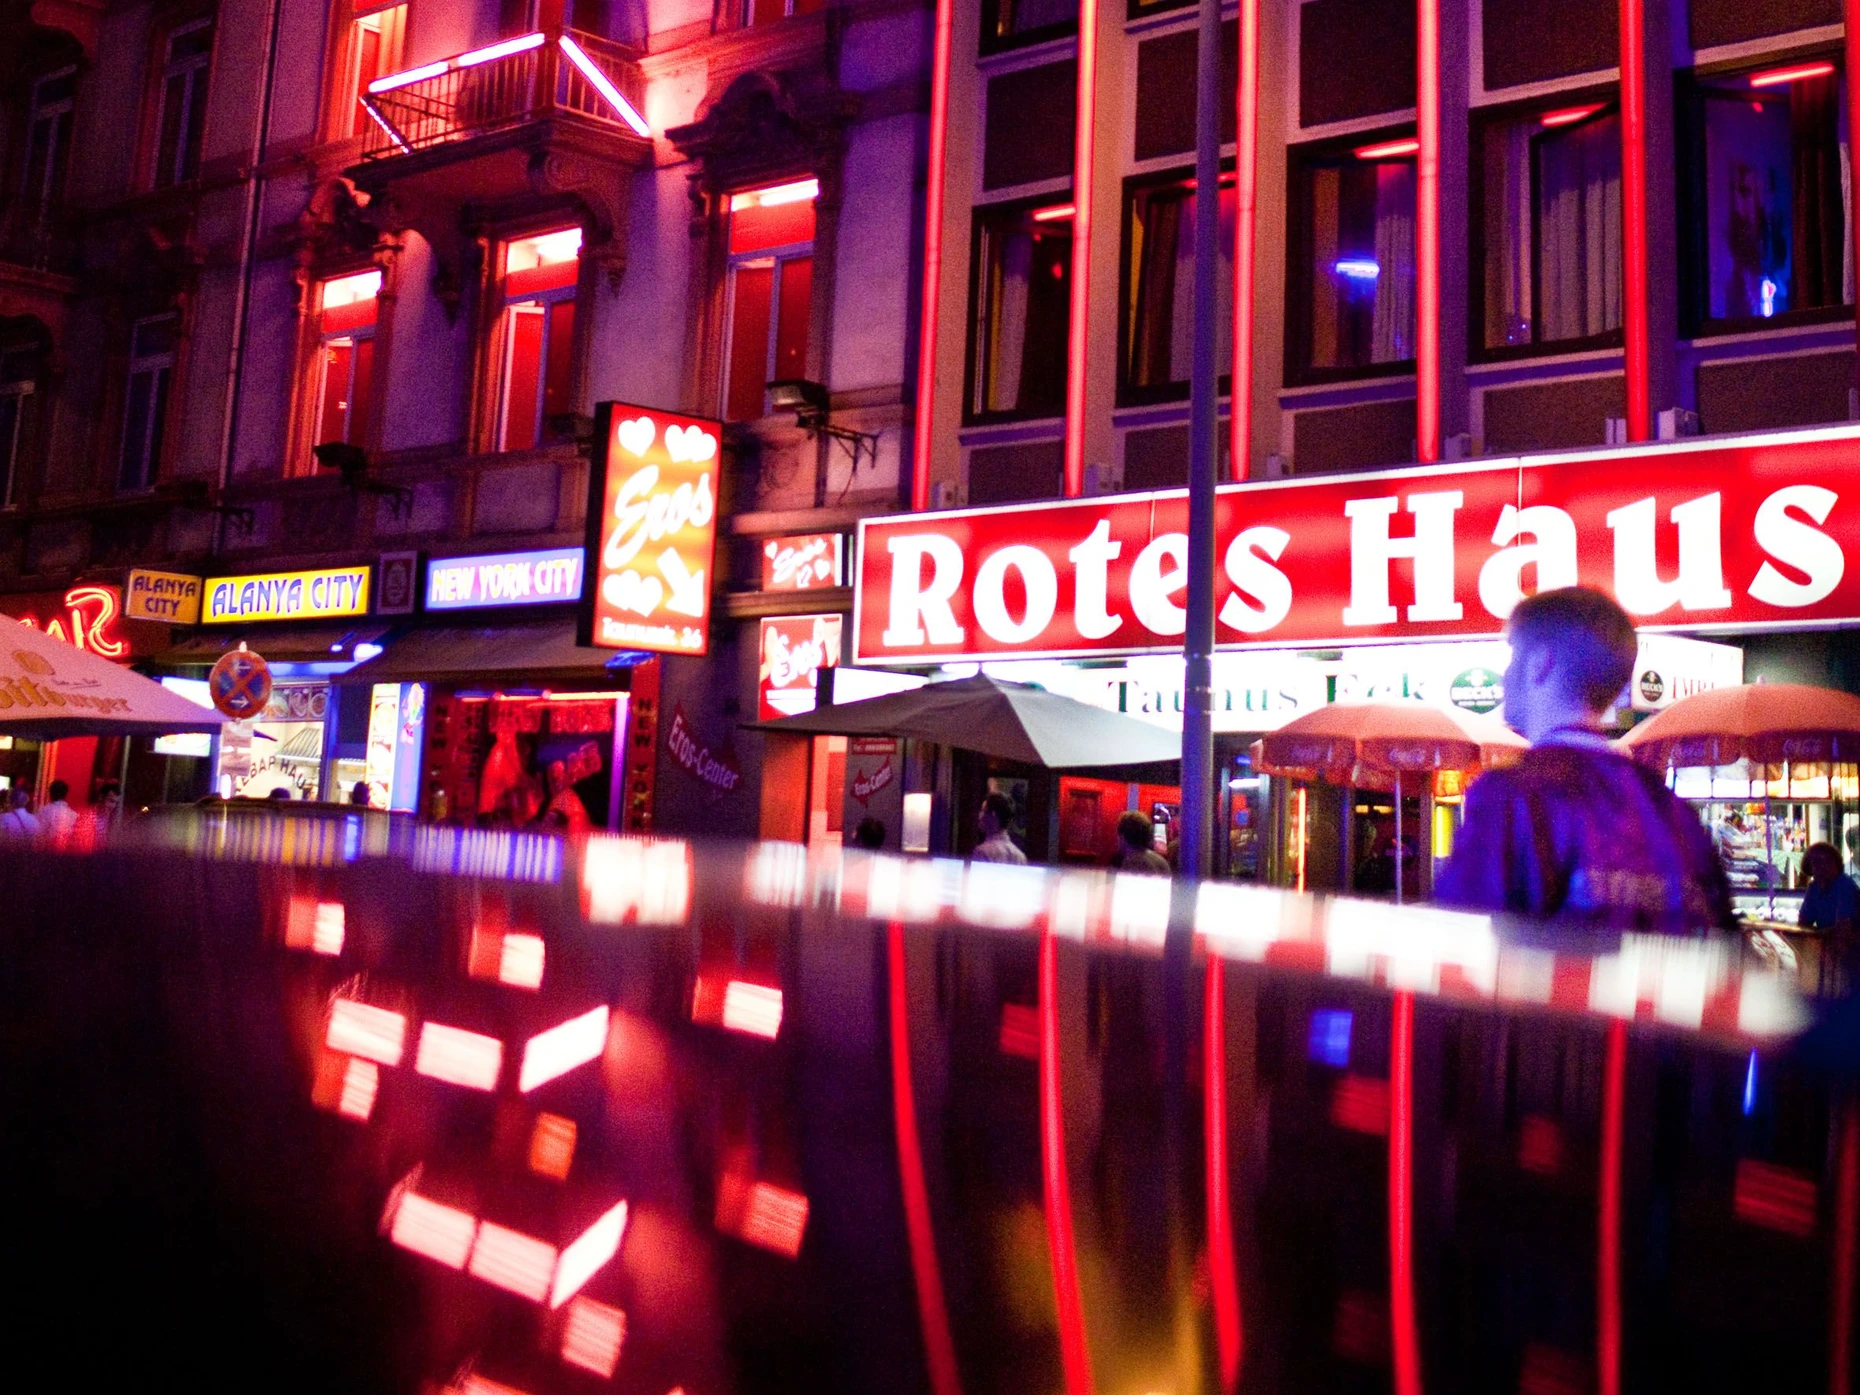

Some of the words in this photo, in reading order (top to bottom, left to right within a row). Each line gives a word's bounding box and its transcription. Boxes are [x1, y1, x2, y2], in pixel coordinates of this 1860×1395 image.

[605, 465, 713, 568] Eros
[133, 575, 197, 597] ALANYA
[431, 566, 476, 602] NEW
[479, 562, 531, 602] YORK
[534, 558, 579, 597] CITY
[883, 519, 1293, 647] Rotes
[1343, 484, 1845, 627] Haus
[144, 596, 180, 617] CITY
[213, 578, 302, 617] ALANYA
[311, 573, 364, 610] CITY
